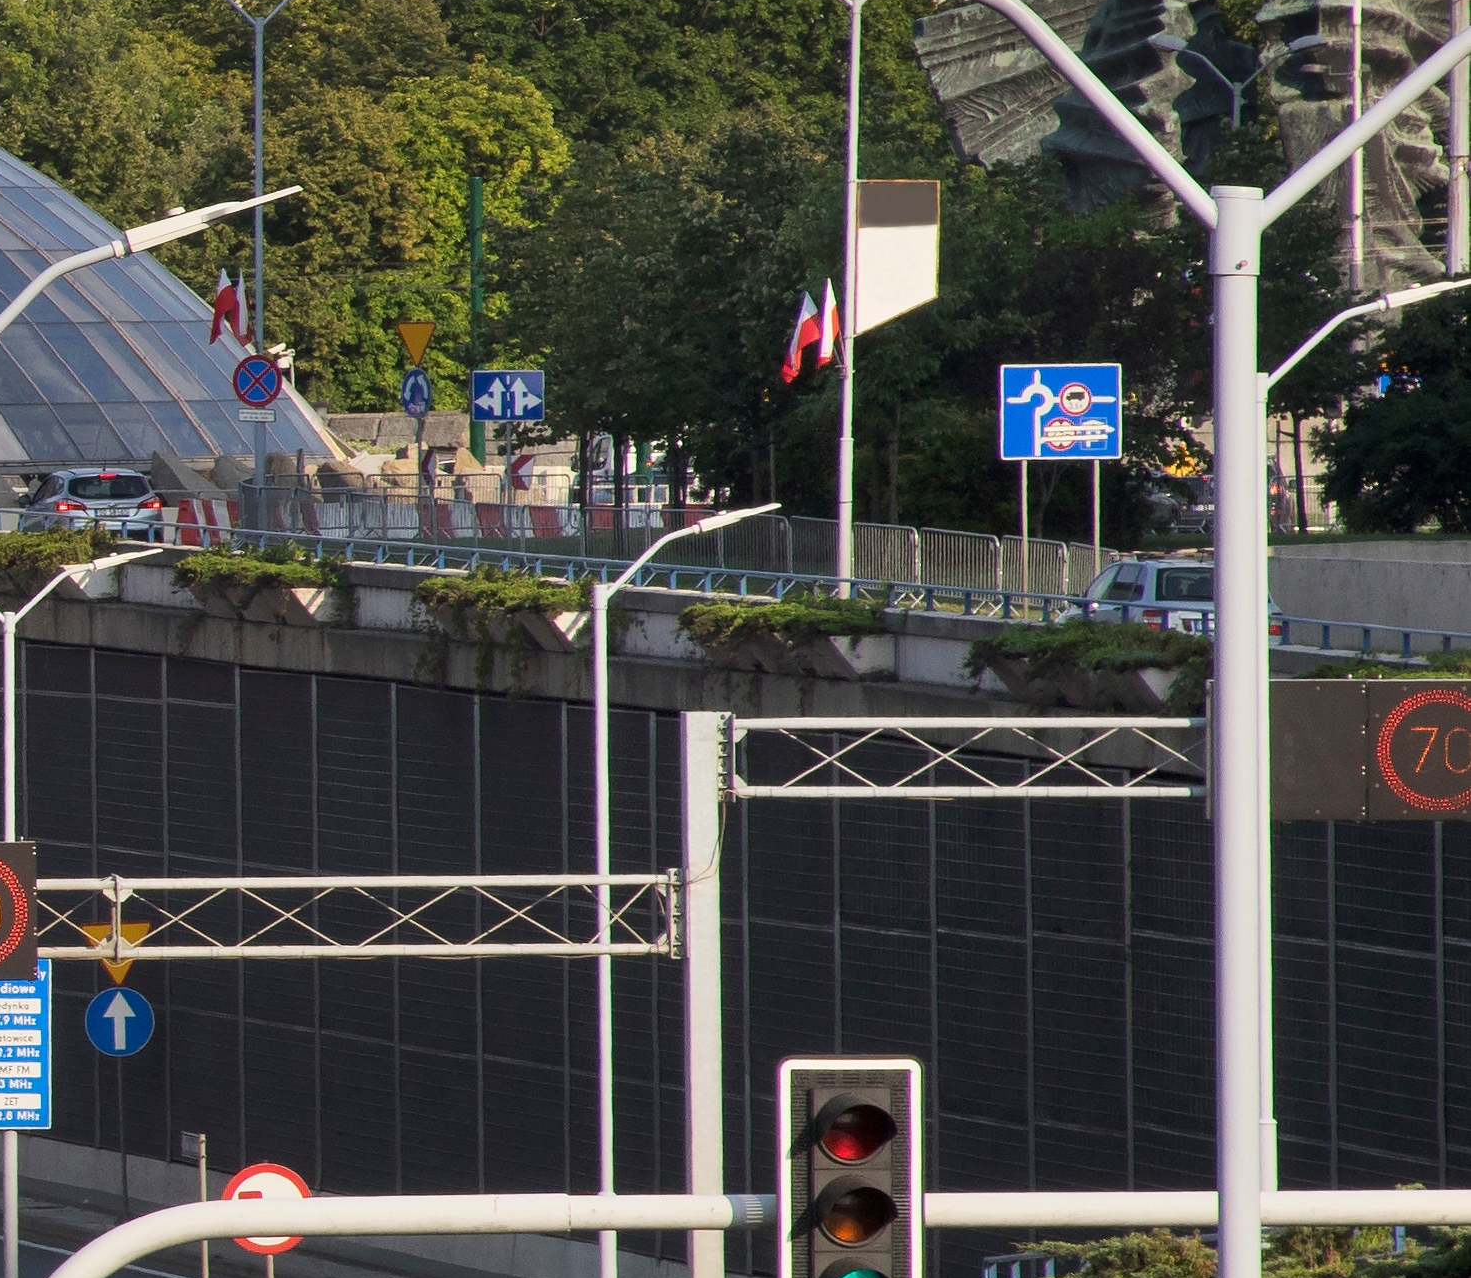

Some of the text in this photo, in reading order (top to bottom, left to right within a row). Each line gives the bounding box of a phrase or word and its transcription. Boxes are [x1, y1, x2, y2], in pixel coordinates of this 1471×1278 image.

[1410, 725, 1471, 775] 70
[13, 1014, 37, 1026] MHz
[16, 1047, 41, 1058] MHz
[16, 1065, 31, 1075] FM
[9, 1078, 33, 1090] MHz
[3, 1096, 20, 1107] ZET
[16, 1110, 41, 1122] MHz
